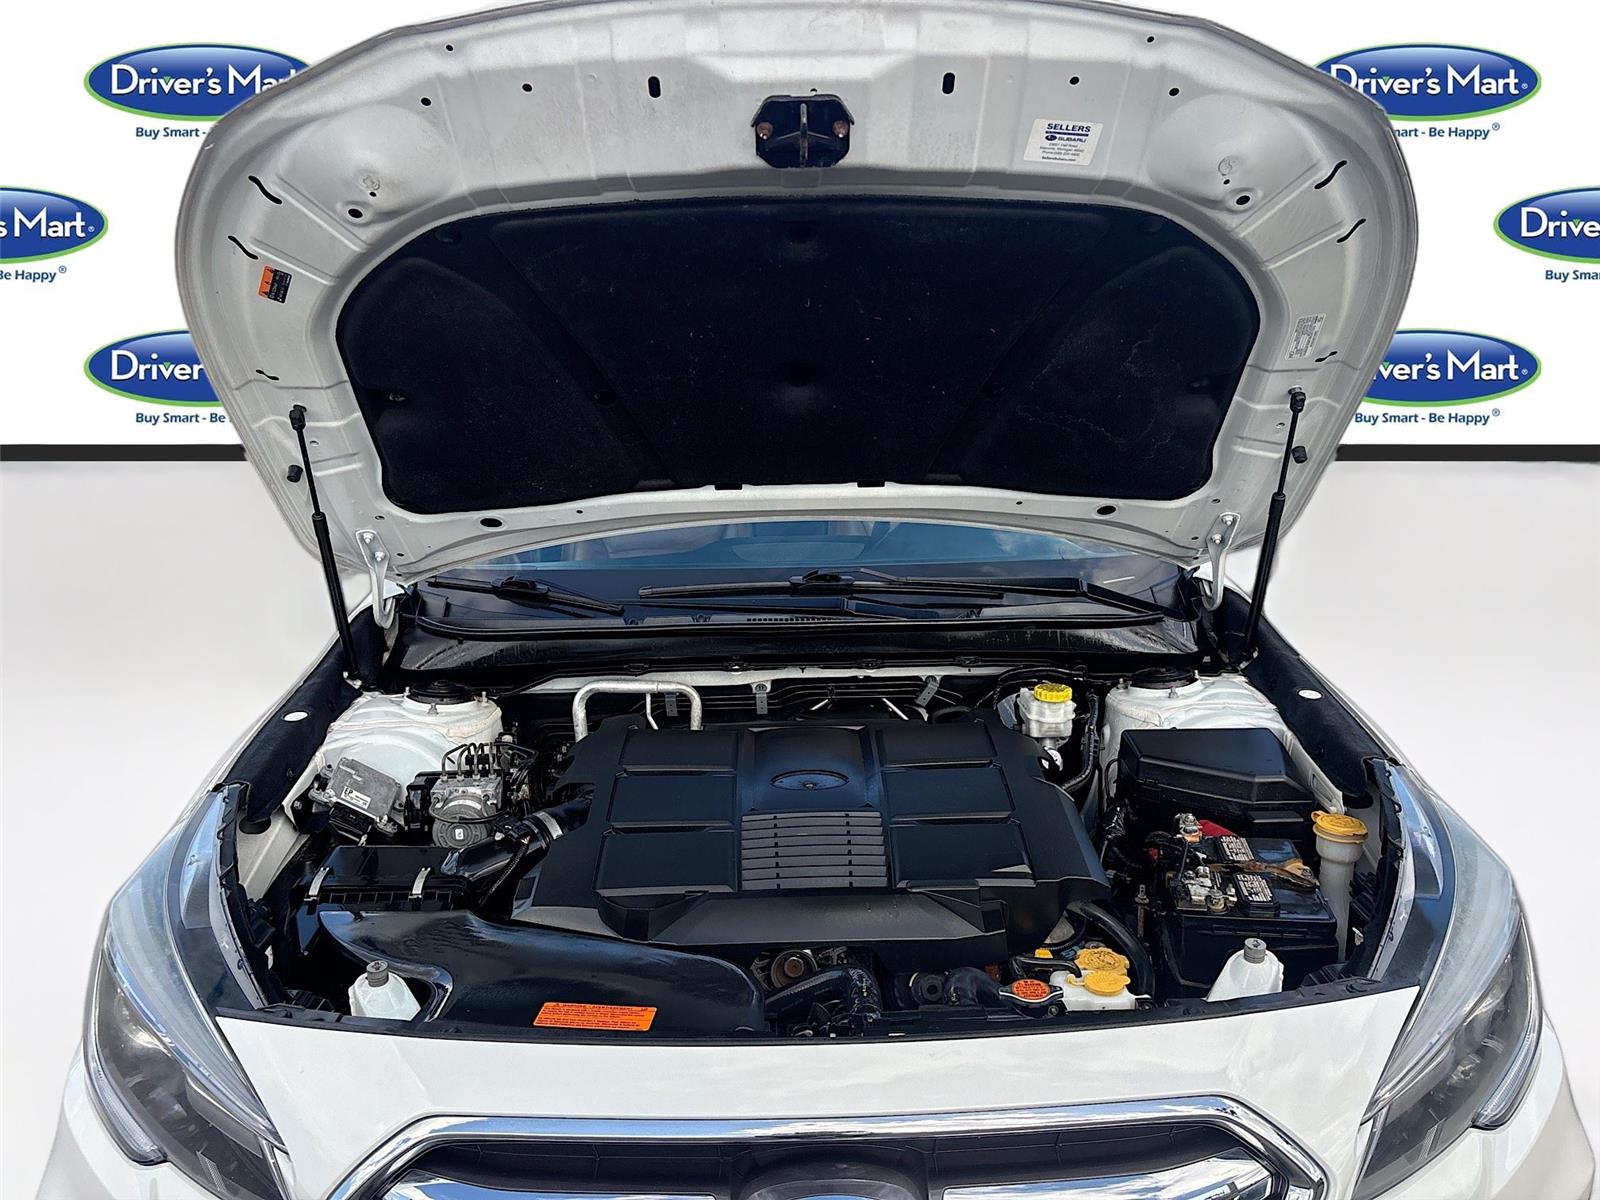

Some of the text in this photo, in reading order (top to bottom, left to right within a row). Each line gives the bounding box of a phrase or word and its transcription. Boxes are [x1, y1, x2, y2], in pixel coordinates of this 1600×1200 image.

[111, 63, 296, 95] Driver's Ma
[1447, 63, 1519, 95] Mart
[135, 126, 161, 140] Buy
[162, 126, 200, 138] Smart
[1046, 123, 1091, 133] SELLERS
[1394, 127, 1419, 138] mart
[1428, 126, 1446, 138] Be
[1448, 126, 1491, 141] Happy
[14, 206, 86, 238] Mart
[1521, 206, 1600, 238] Drive
[14, 269, 57, 284] Happy
[1544, 269, 1600, 284] Buy Sma
[111, 349, 204, 381] Driver
[1374, 349, 1519, 380] ver's Mart
[135, 412, 161, 427] Buy
[162, 412, 200, 424] Smart
[209, 412, 226, 424] Be
[1354, 412, 1380, 427] Buy
[1381, 412, 1419, 424] Smart
[1428, 412, 1446, 424] Be
[1448, 412, 1491, 427] Happy
